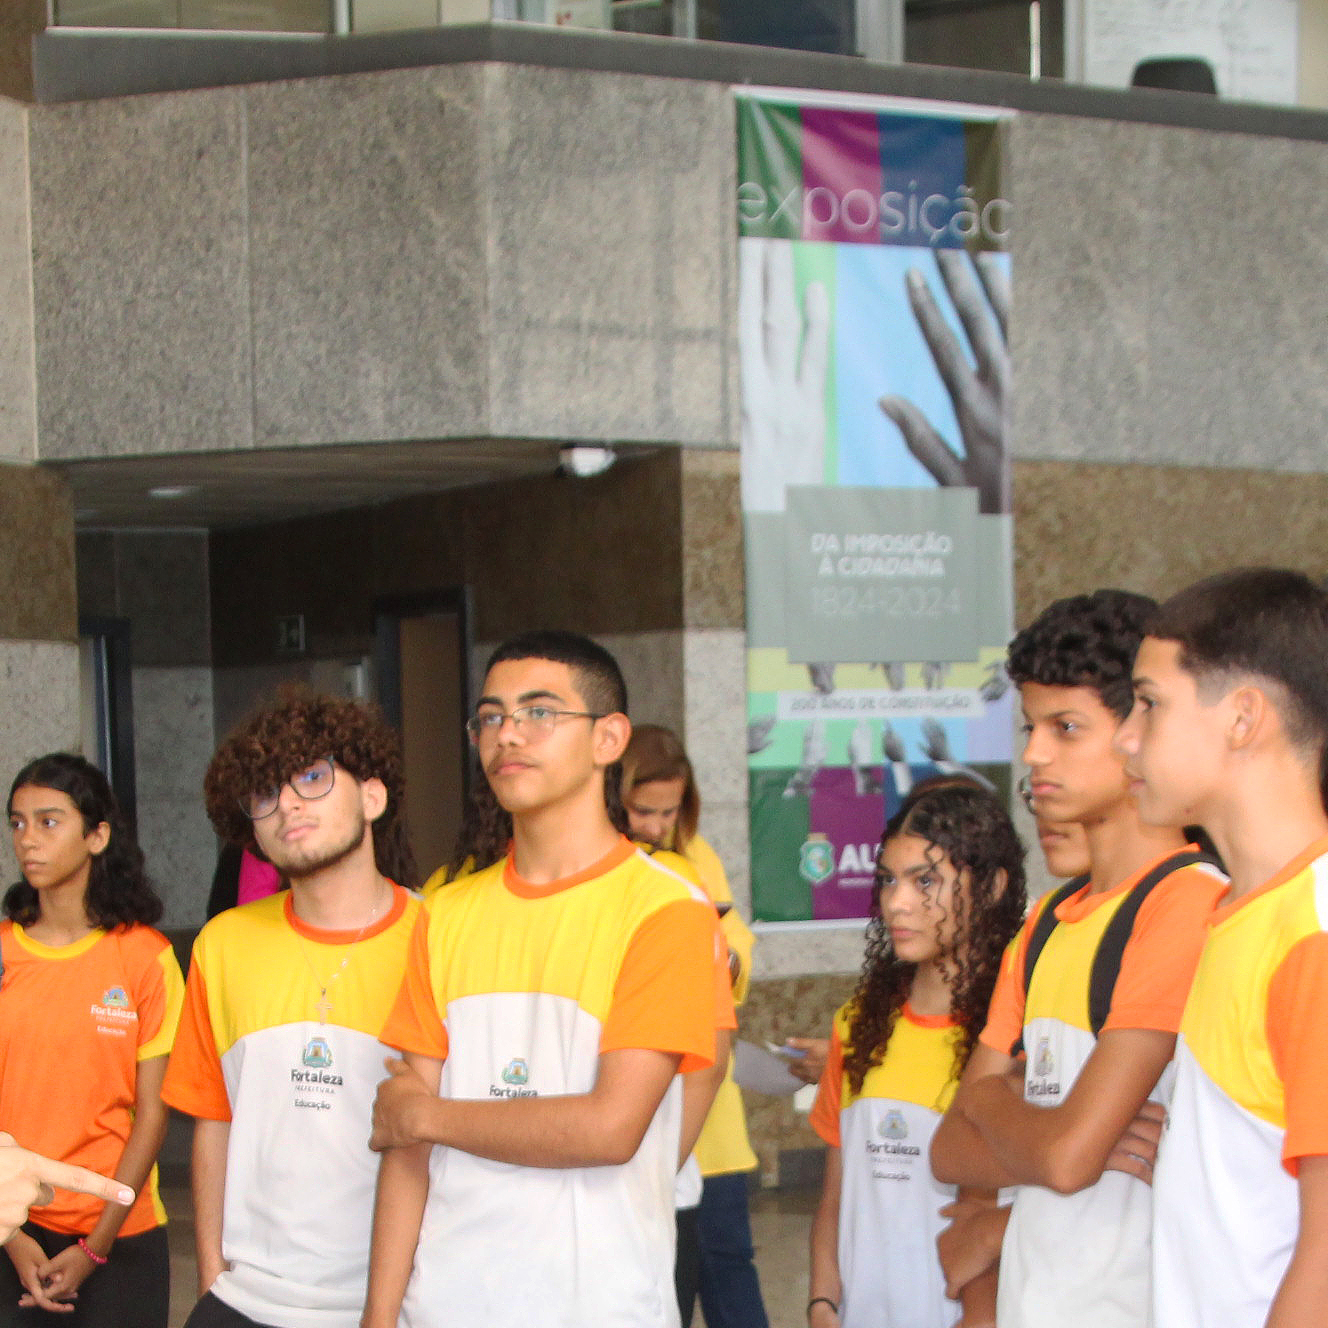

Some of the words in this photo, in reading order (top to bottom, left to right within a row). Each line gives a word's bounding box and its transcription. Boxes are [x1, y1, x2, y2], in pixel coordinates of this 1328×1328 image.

[810, 532, 840, 552] DA
[844, 530, 953, 554] IMPOSIÇÃO
[837, 556, 945, 577] CIDADANIA
[91, 1004, 138, 1019] Fortaleza
[291, 1069, 343, 1086] Fortaleza
[490, 1085, 538, 1097] Fortaleza
[295, 1099, 331, 1110] Educação
[866, 1140, 920, 1155] Fortaleza
